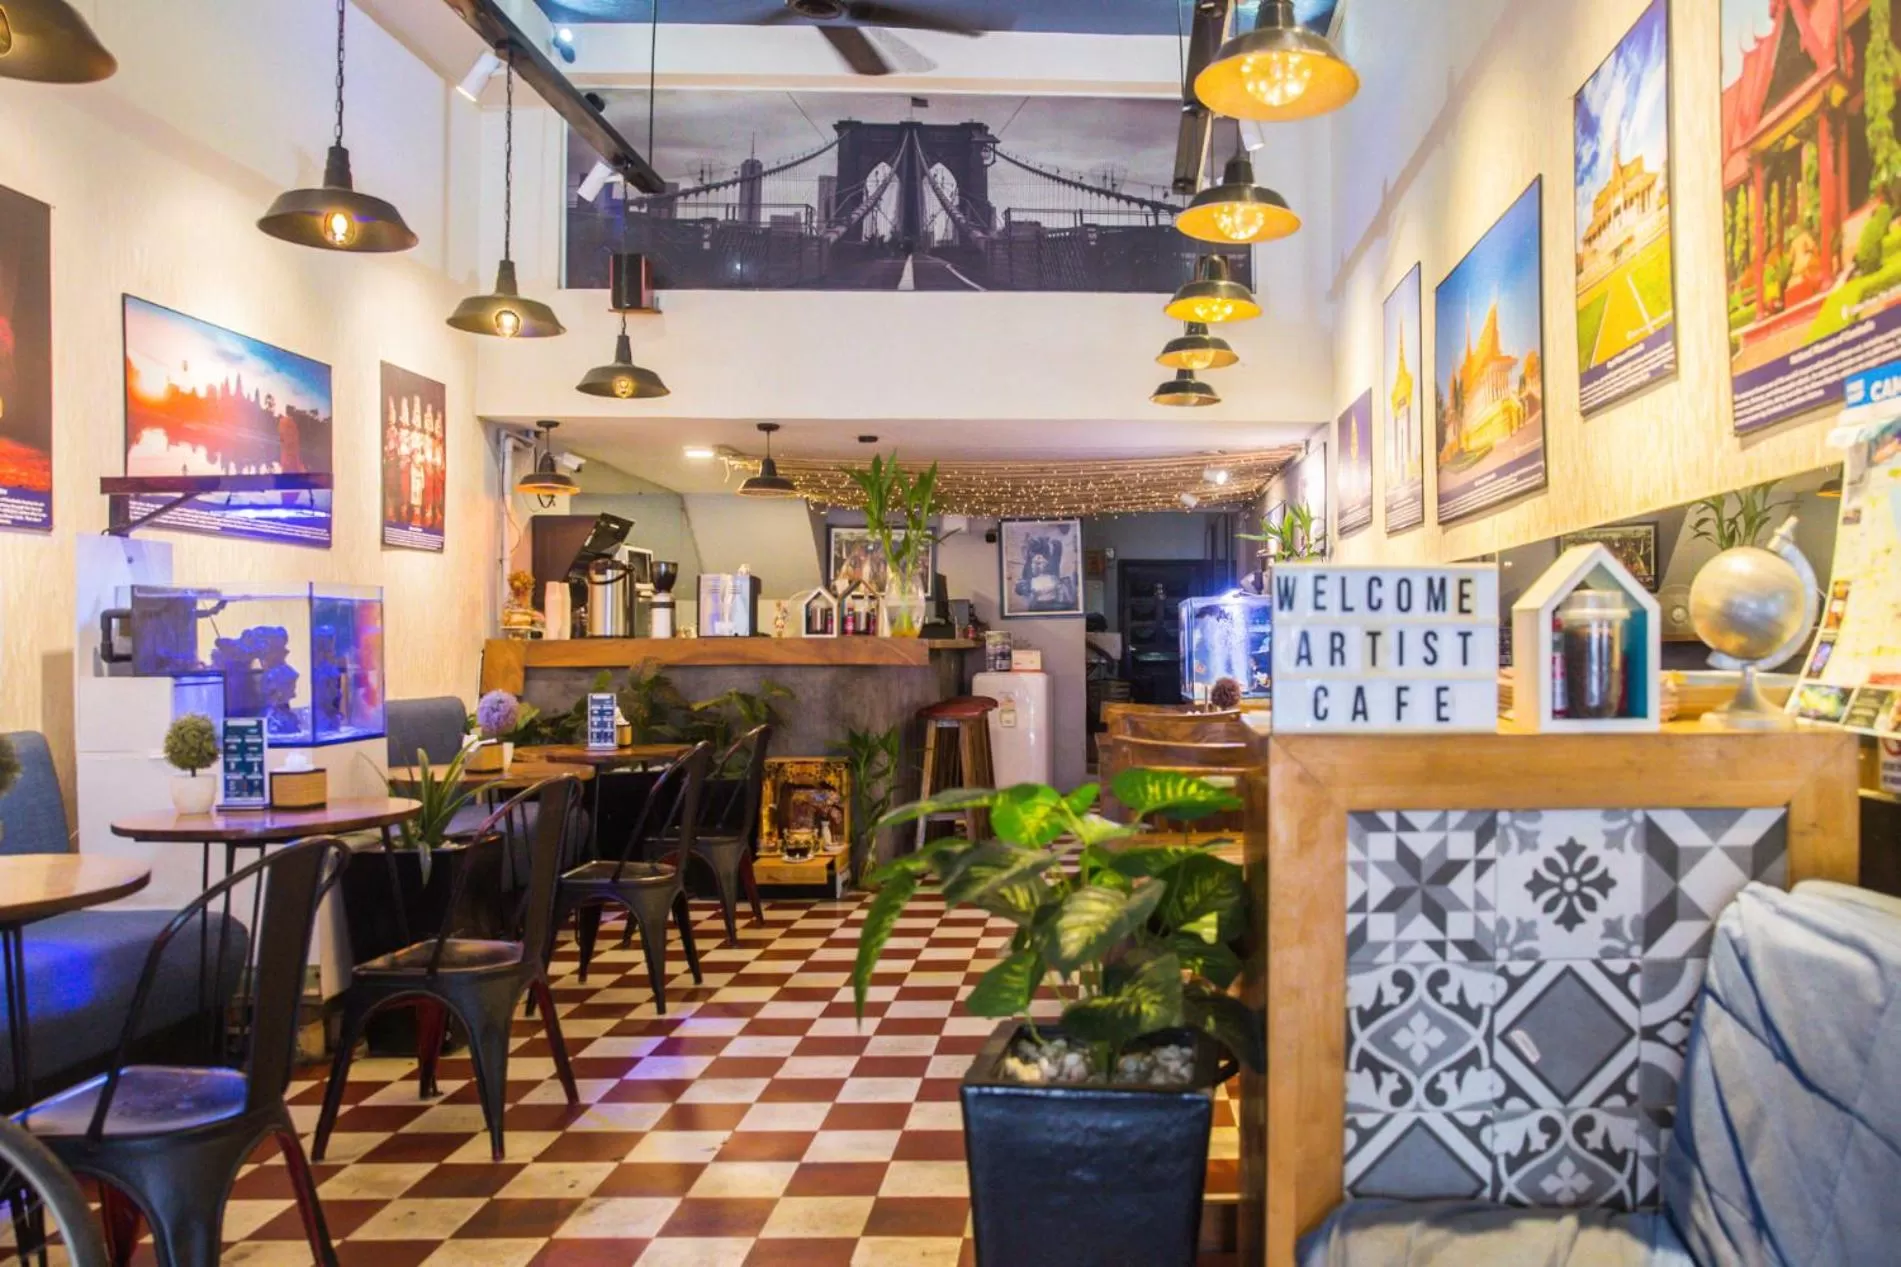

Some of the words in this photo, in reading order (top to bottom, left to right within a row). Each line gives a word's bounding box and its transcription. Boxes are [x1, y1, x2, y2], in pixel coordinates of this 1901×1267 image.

[1276, 574, 1473, 614] WELCOME
[1296, 630, 1473, 667] ARTIST
[1313, 685, 1450, 723] CAFE
